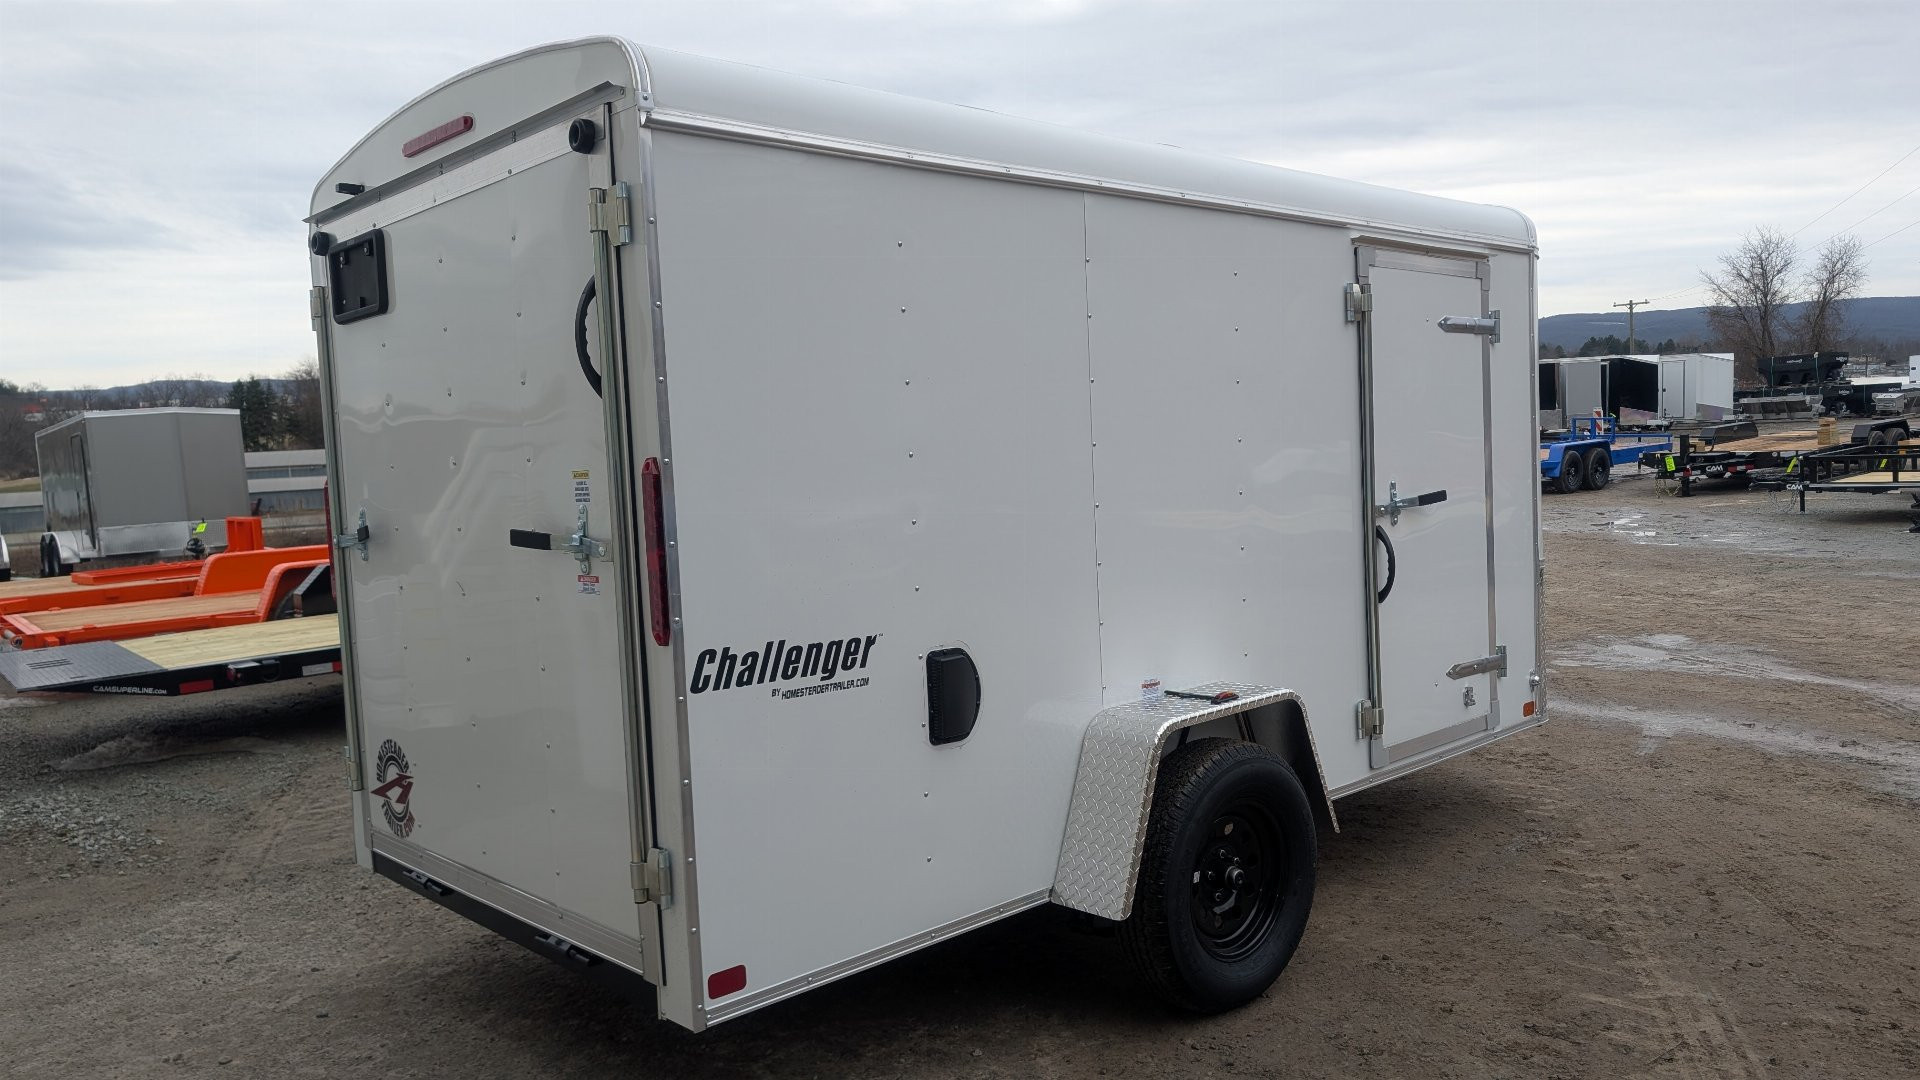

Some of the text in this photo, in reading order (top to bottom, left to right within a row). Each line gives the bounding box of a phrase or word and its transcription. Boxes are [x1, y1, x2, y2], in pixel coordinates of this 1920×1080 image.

[771, 677, 869, 700] BY HOMESTEADERTRAILER.COM
[376, 739, 411, 784] HOMESTEADER
